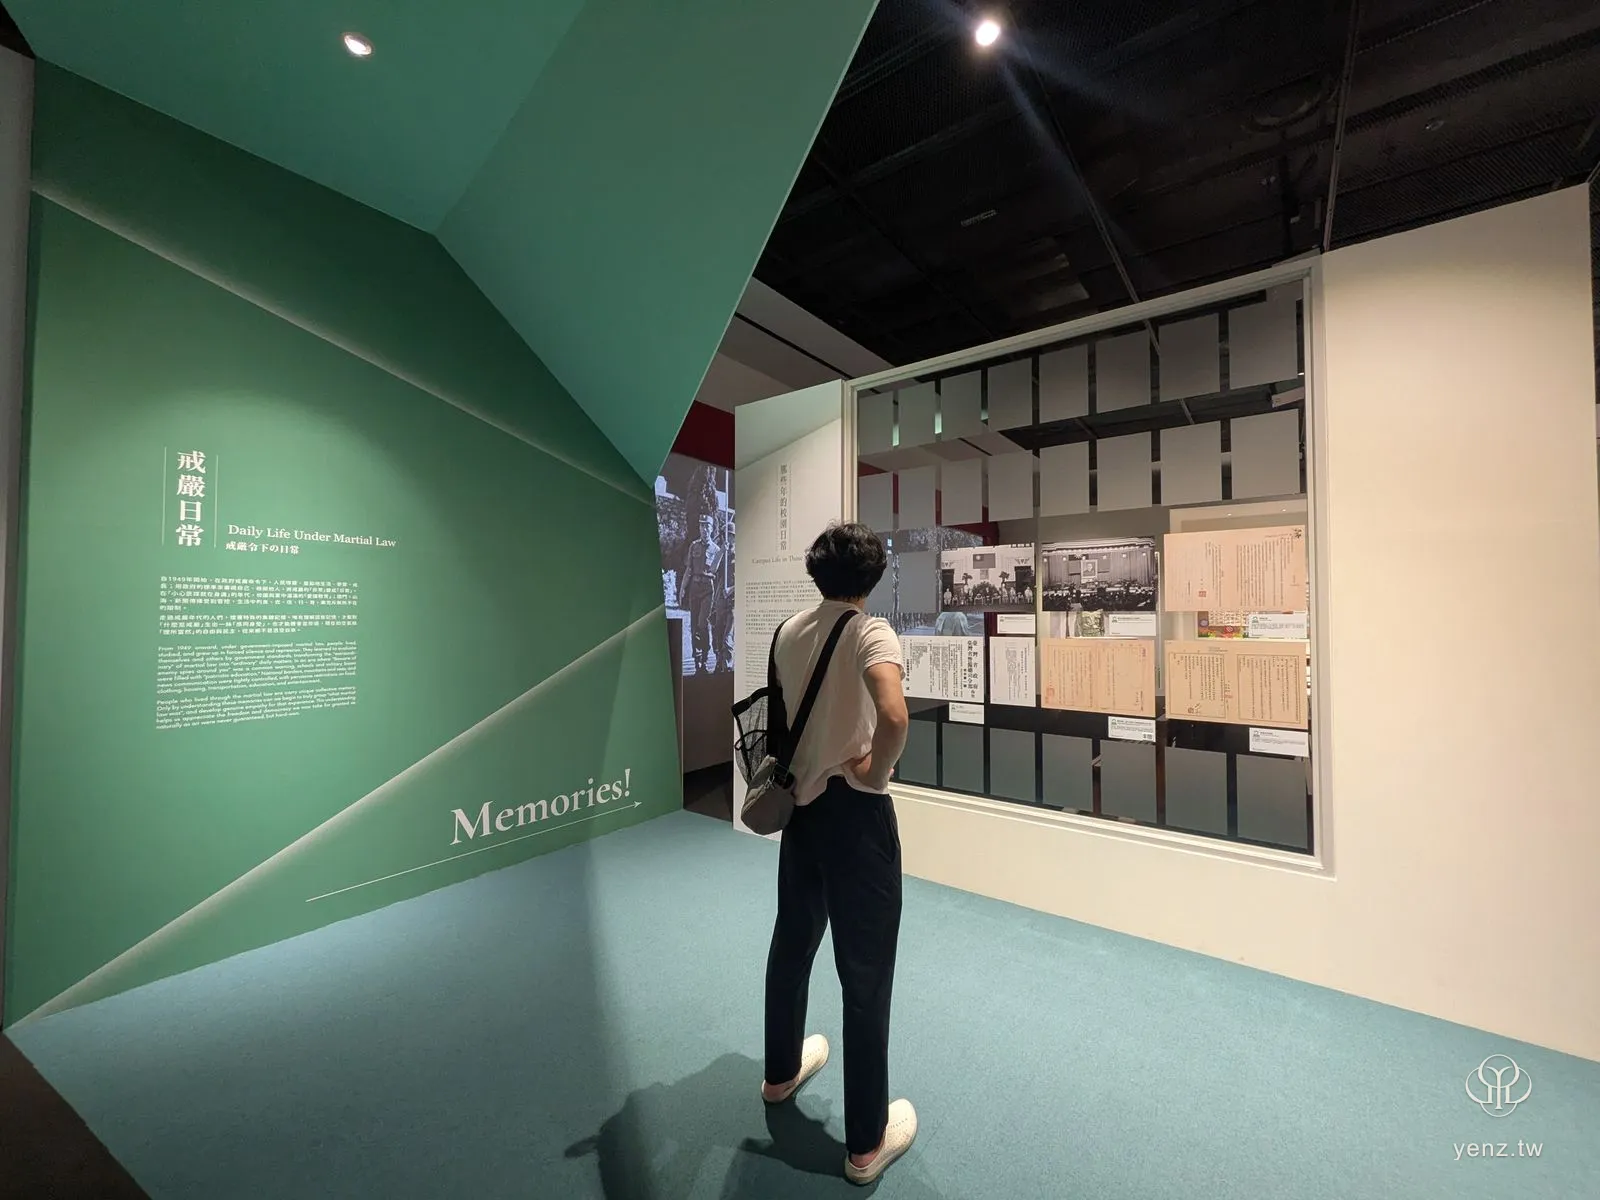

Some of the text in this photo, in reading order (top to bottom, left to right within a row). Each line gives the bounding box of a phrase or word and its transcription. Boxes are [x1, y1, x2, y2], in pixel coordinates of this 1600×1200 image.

[176, 450, 206, 546] 戒嚴日常
[228, 524, 396, 548] Daily Life Under Martial Law
[450, 768, 631, 845] Memories!
